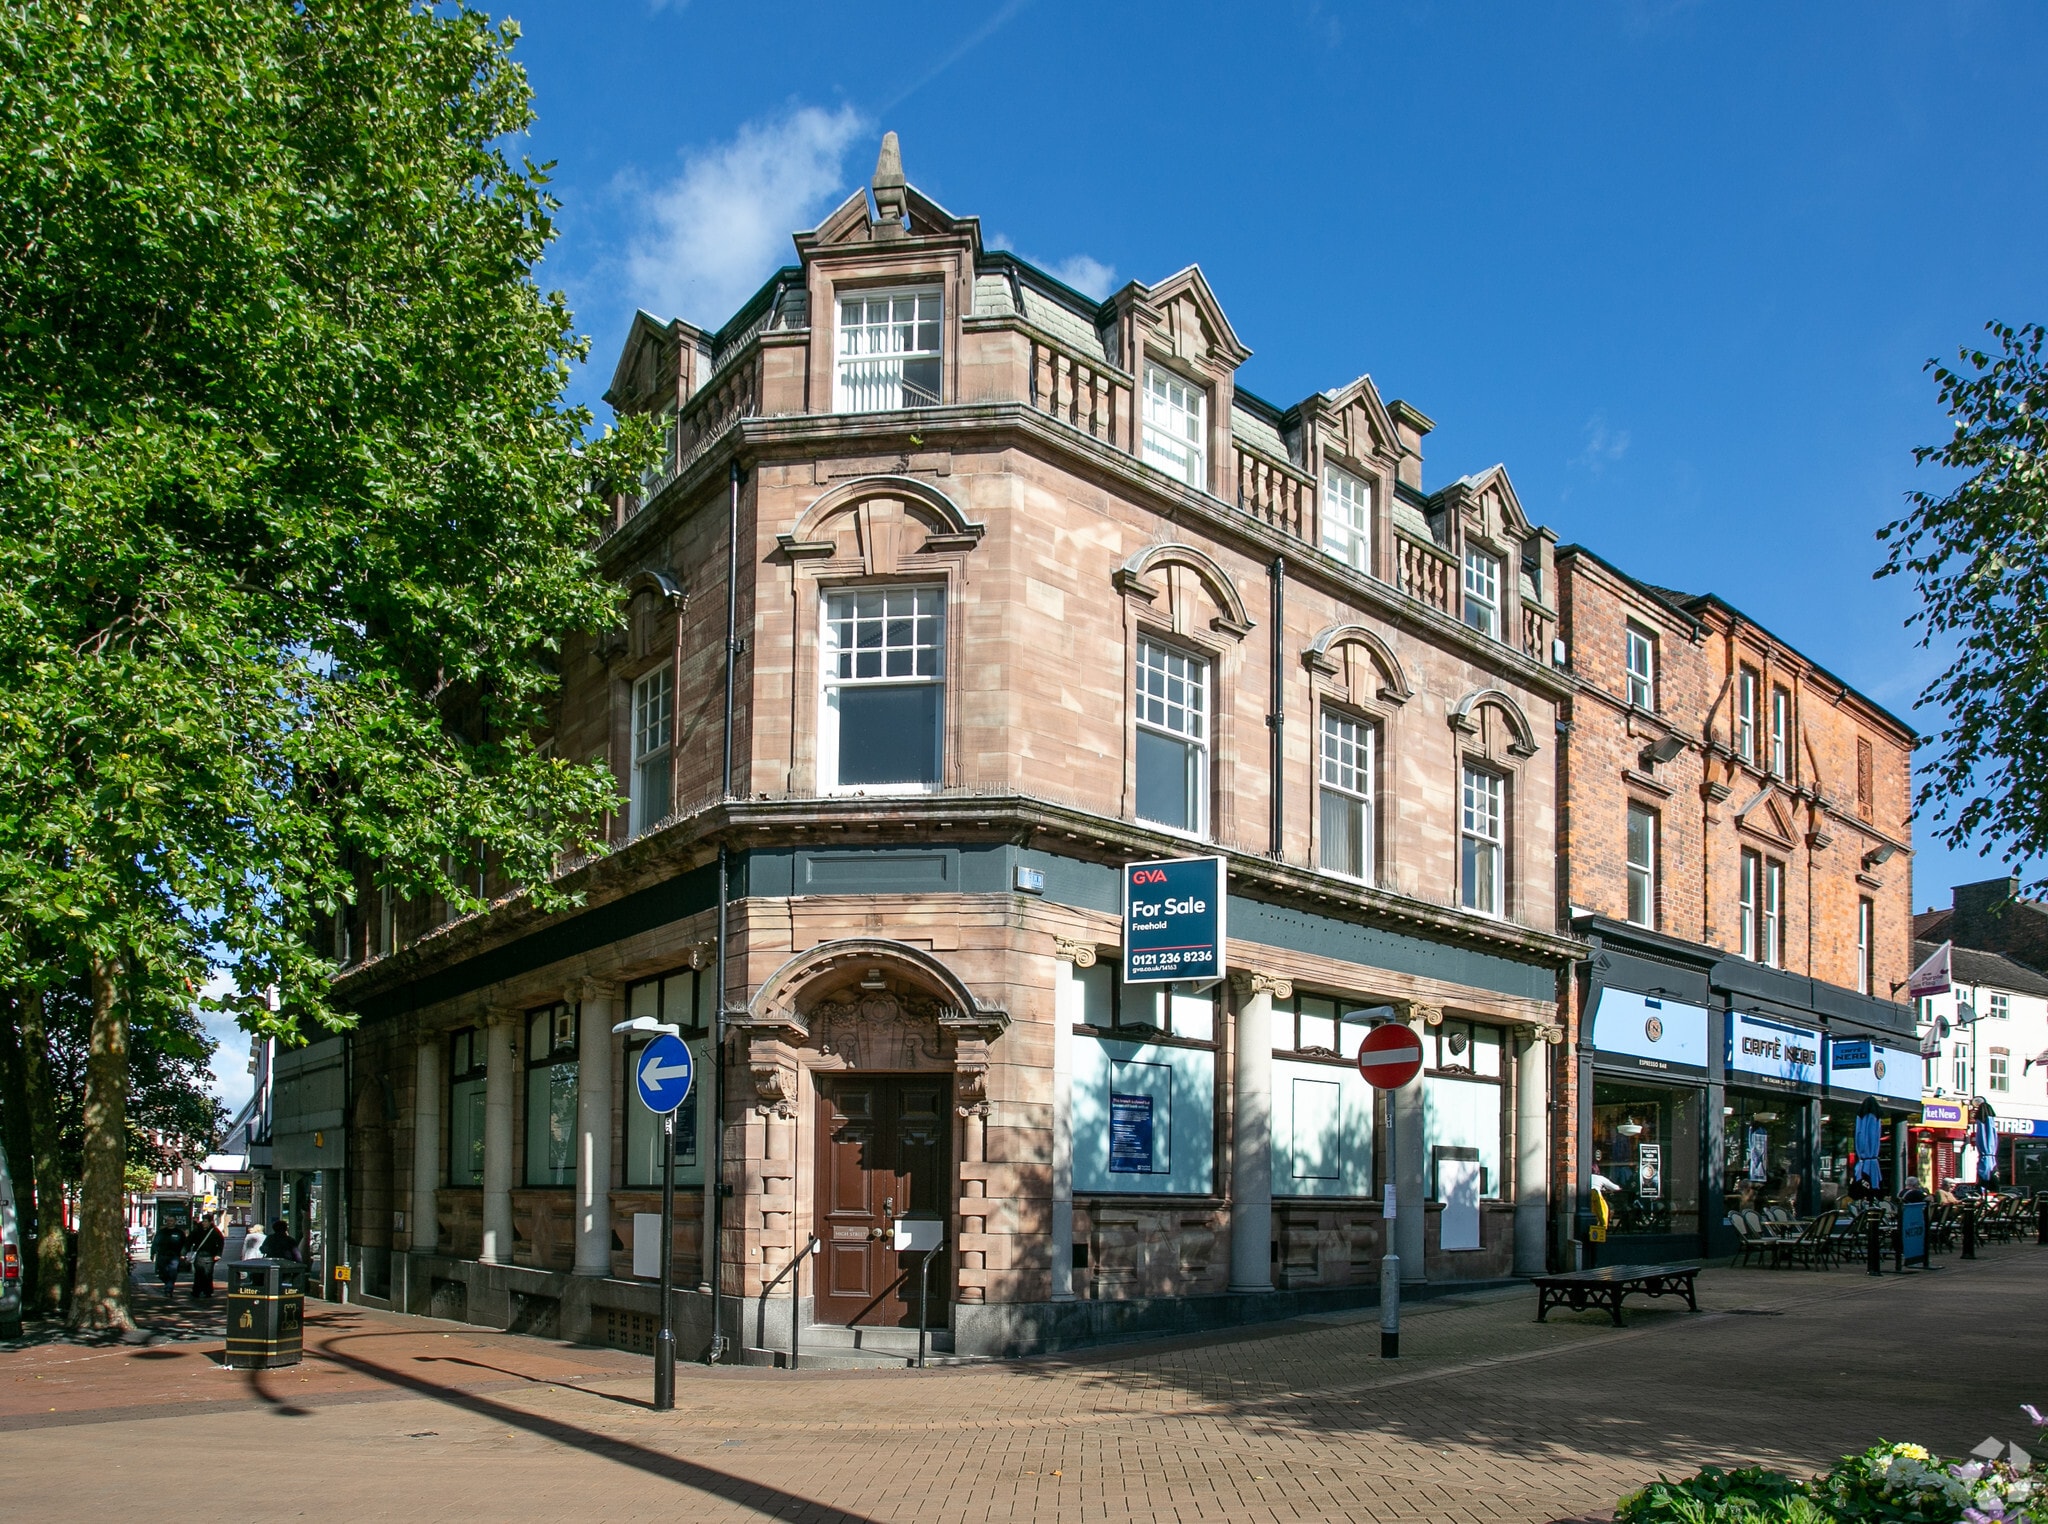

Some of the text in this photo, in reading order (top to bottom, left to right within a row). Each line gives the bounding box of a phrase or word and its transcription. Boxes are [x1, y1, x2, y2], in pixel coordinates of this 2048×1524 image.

[1132, 870, 1167, 884] GVA
[1132, 896, 1206, 918] For Sale
[1132, 921, 1167, 931] Freehold
[1132, 950, 1213, 965] 0121 236 8236
[1742, 1036, 1817, 1066] CAFFÈ NERO
[1835, 1053, 1867, 1061] NERO
[1938, 1107, 1957, 1119] News
[240, 1287, 258, 1295] Litter
